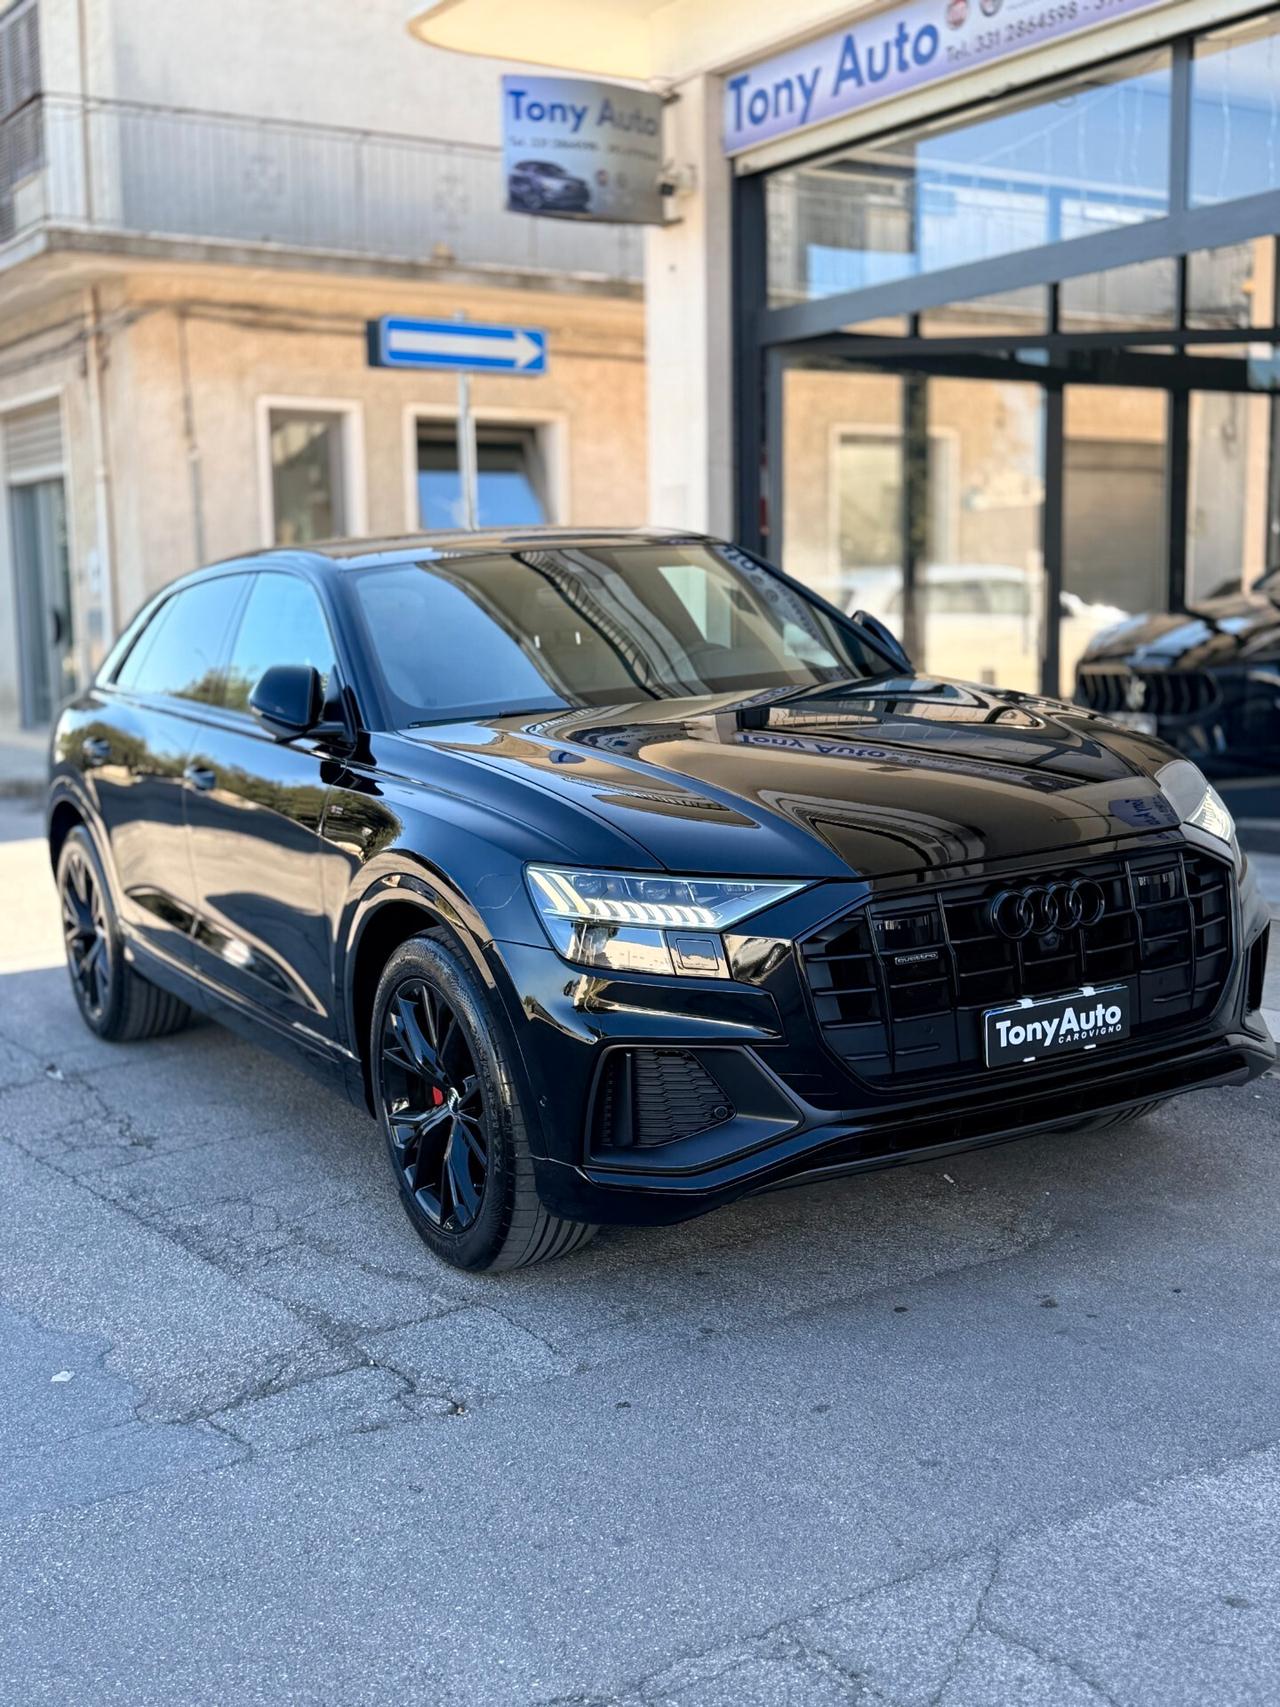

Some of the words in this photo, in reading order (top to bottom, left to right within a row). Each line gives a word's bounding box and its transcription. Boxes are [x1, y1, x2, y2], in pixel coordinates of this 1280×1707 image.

[727, 66, 821, 131] Tony
[832, 21, 939, 97] Auto
[507, 90, 589, 133] Tony
[596, 98, 658, 137] Auto
[995, 1003, 1122, 1048] TonyAuto
[1058, 1024, 1122, 1044] CAROVIGNO
